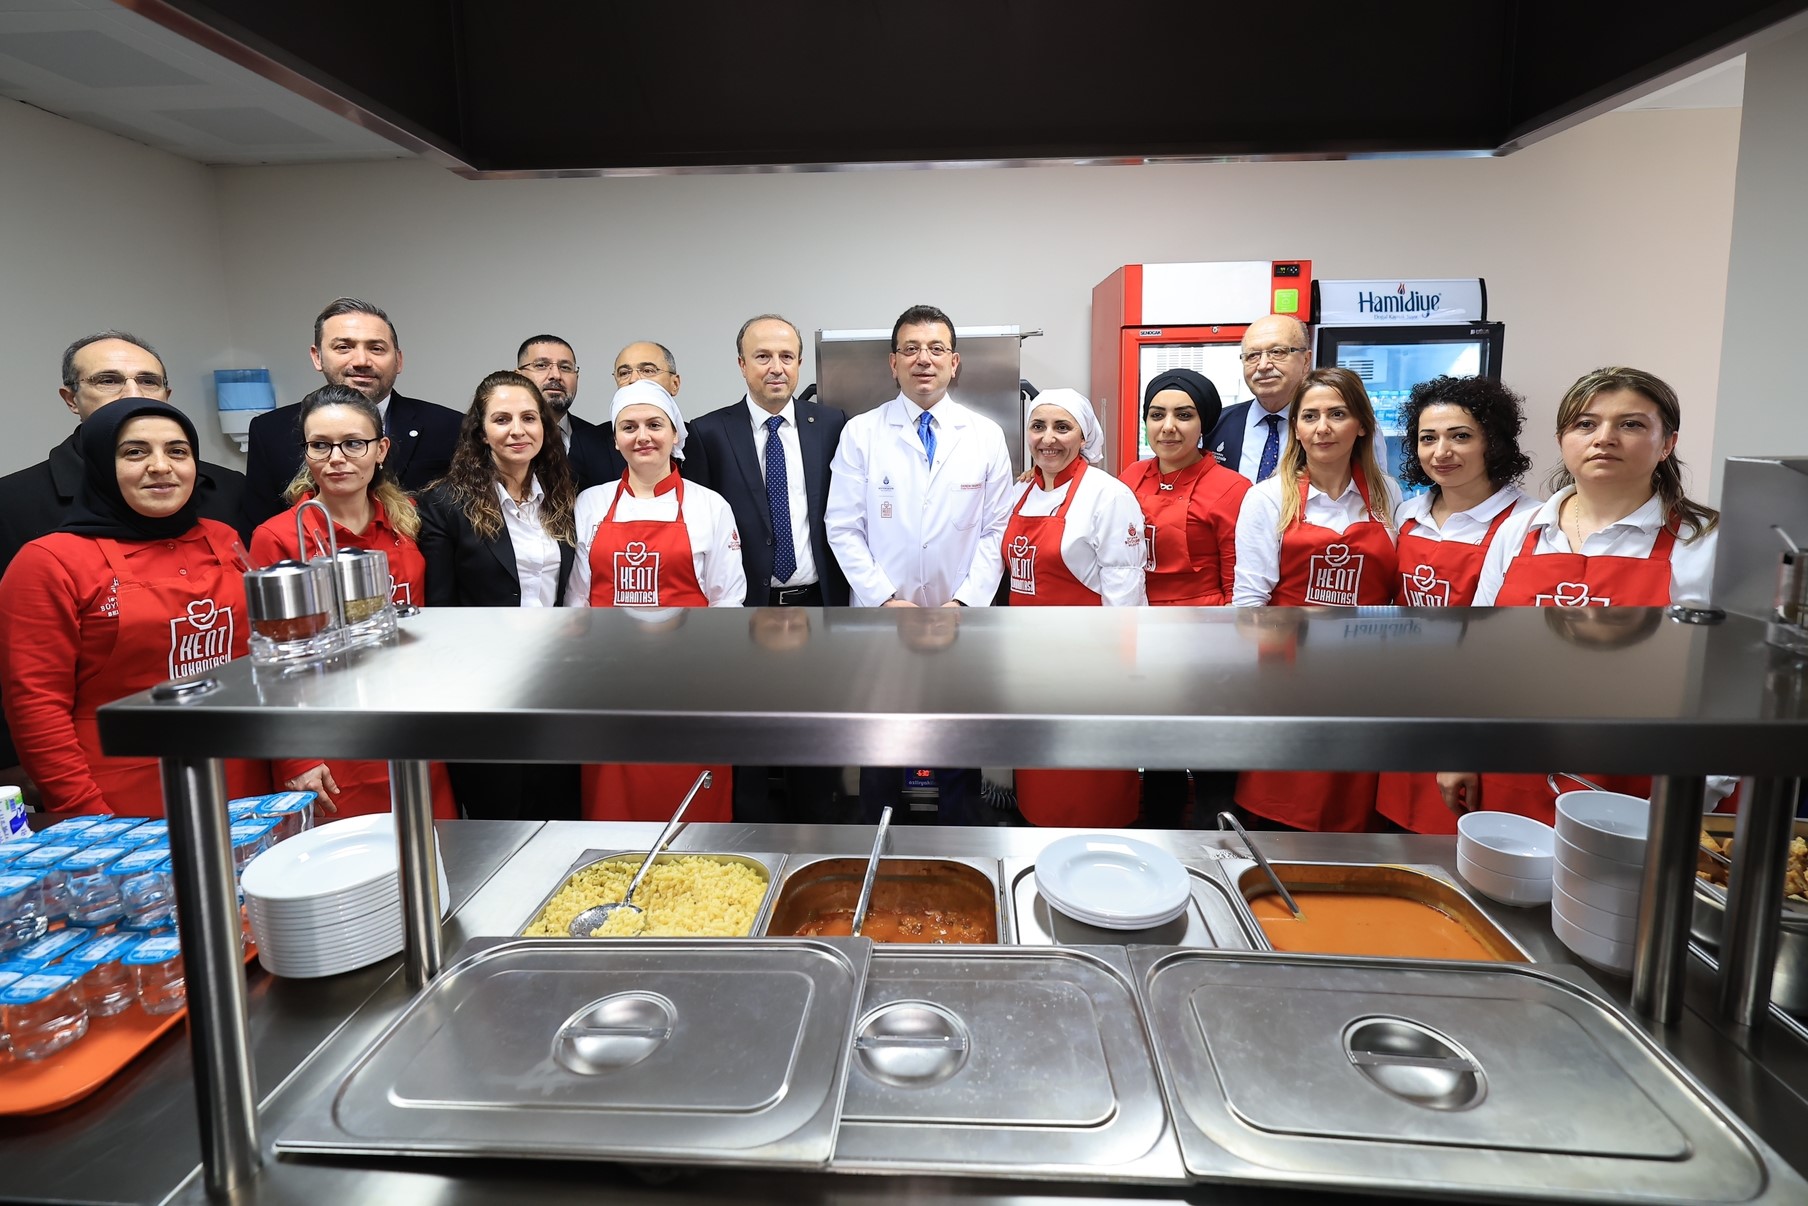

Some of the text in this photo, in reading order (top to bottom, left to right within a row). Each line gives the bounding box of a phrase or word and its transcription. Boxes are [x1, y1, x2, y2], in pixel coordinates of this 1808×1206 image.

[1358, 289, 1441, 318] Hamidiye
[620, 566, 654, 590] KENT
[1316, 568, 1356, 591] KENT
[617, 590, 656, 604] LOKANTASI
[1310, 587, 1356, 605] LOKANTASI
[180, 626, 228, 661] KENT
